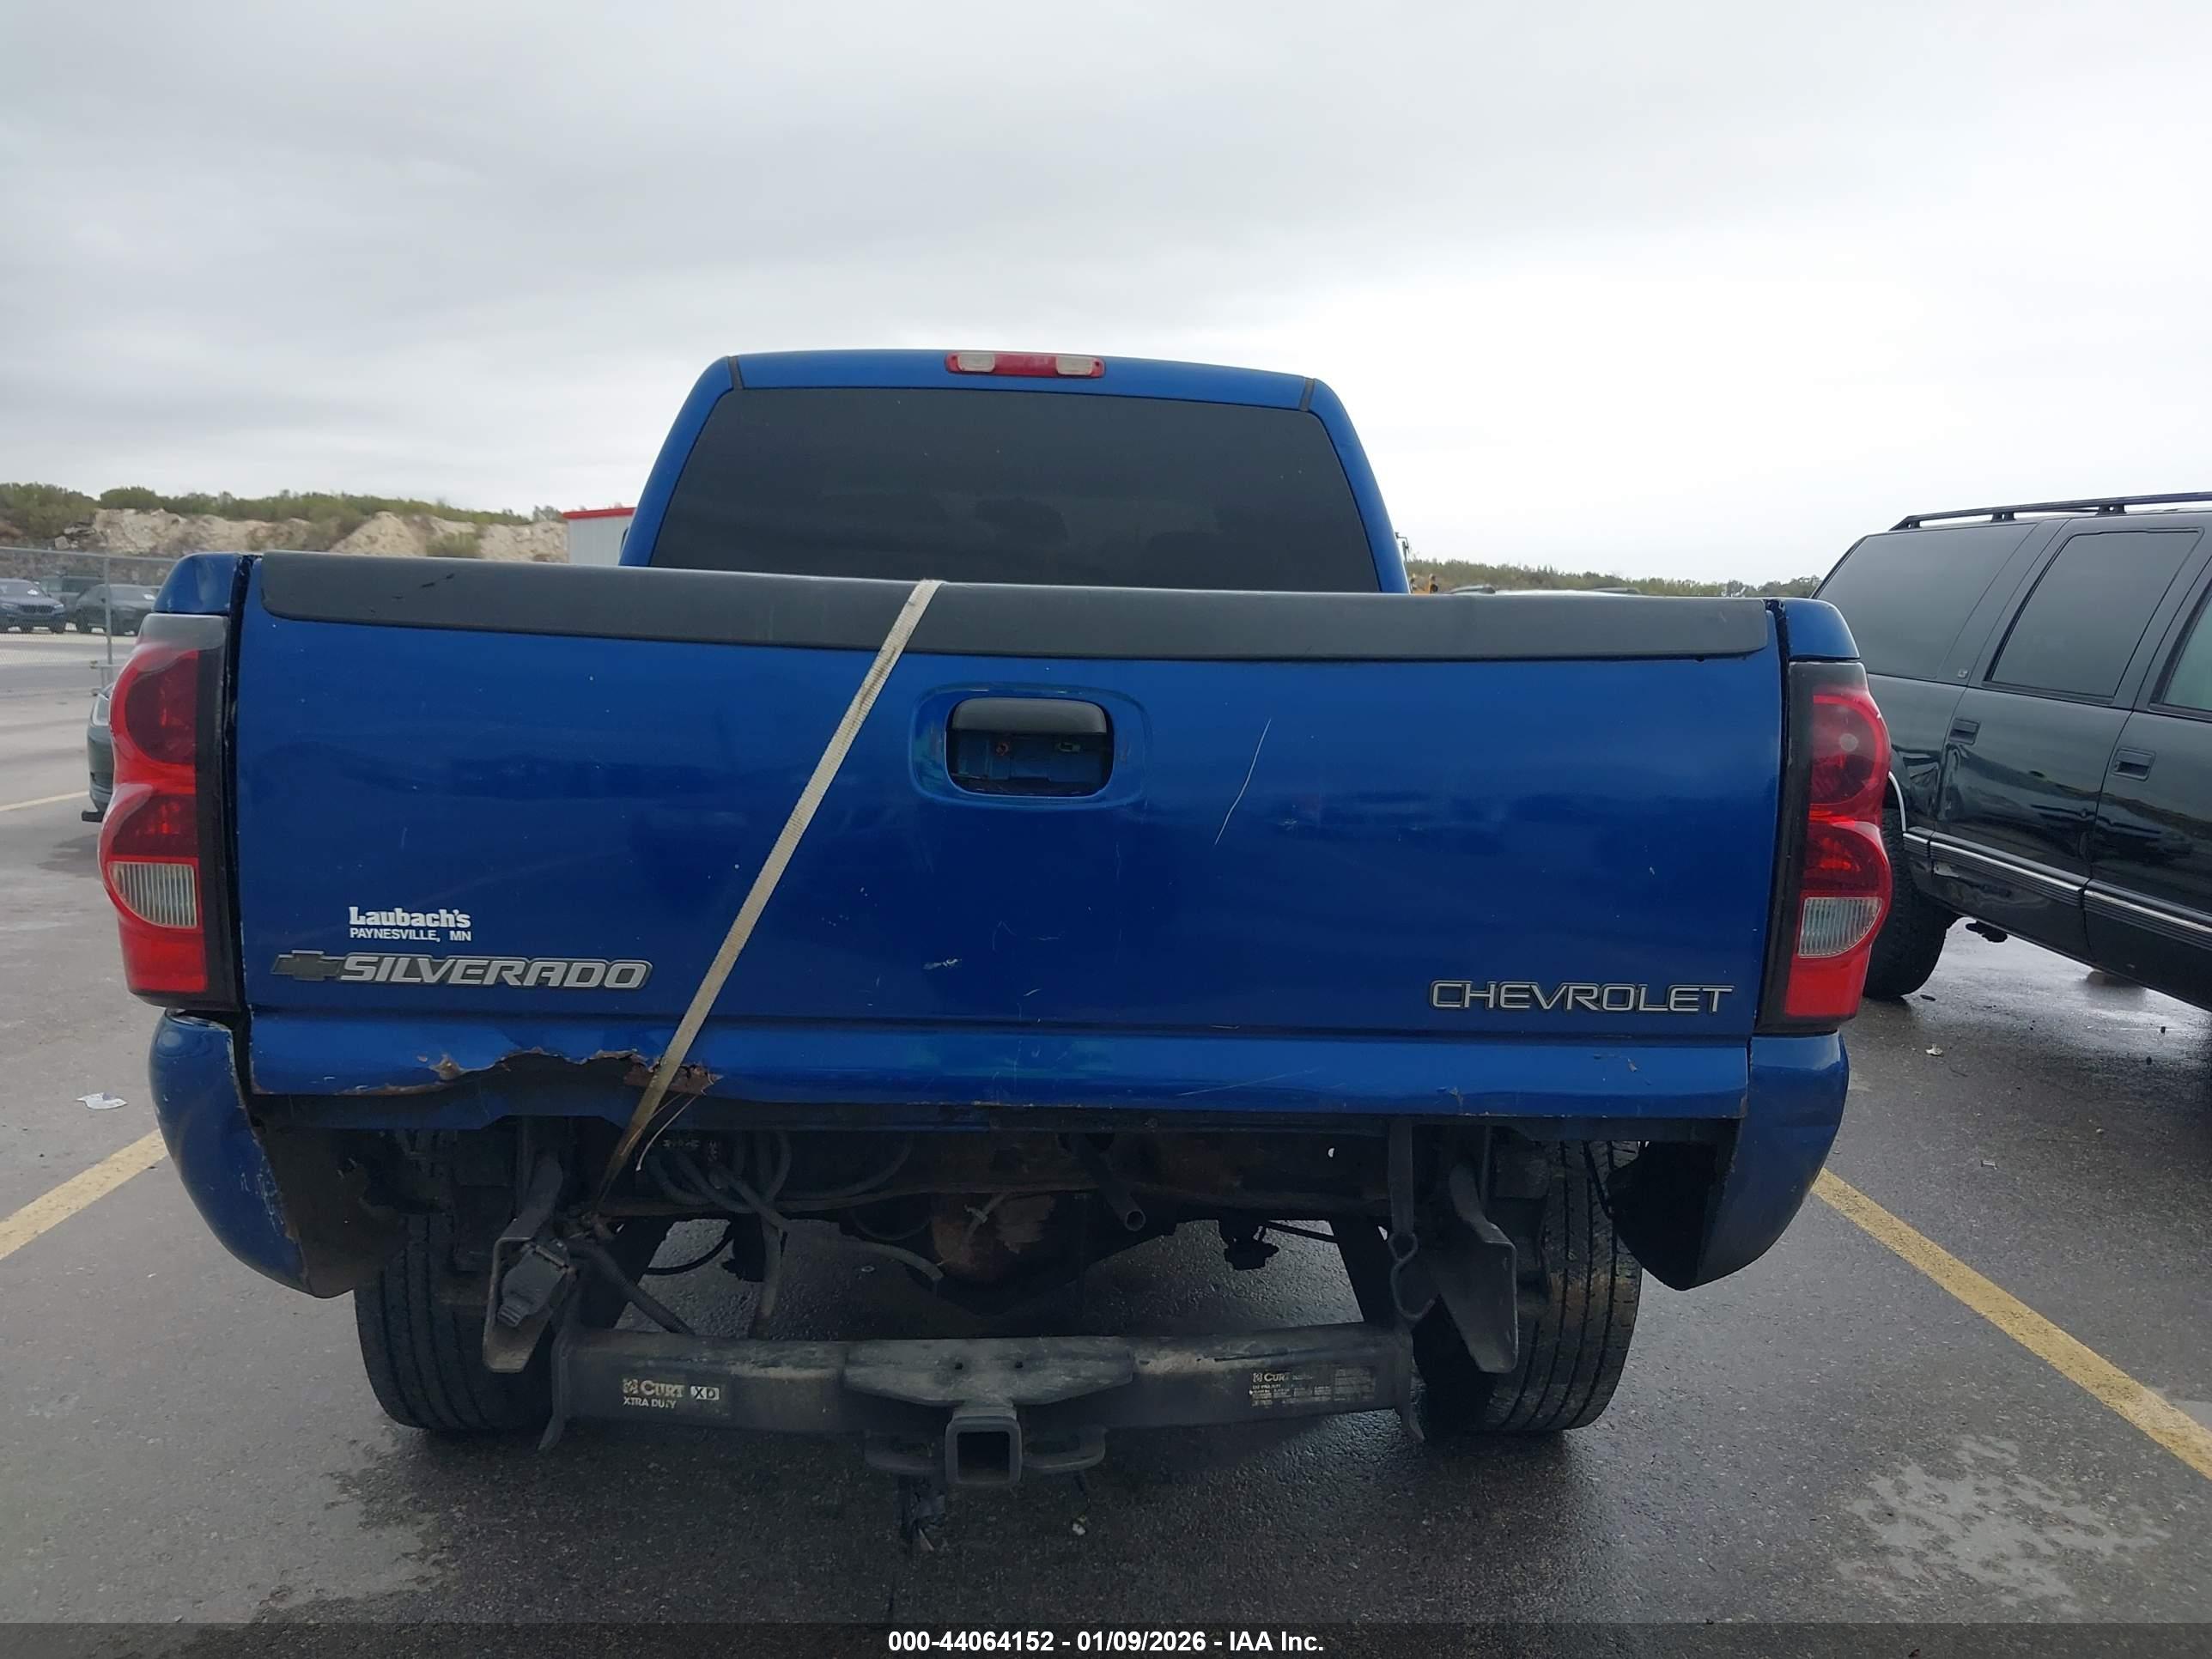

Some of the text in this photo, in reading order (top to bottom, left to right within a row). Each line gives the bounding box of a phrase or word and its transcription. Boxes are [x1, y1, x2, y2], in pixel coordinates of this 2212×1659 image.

[349, 906, 471, 928] Laubach's
[349, 927, 471, 943] PAYNESVILLE, MN
[340, 953, 653, 988] SILVERADO
[1431, 981, 1735, 1012] CHEVROLET
[640, 1380, 719, 1401] CURT XD
[623, 1396, 649, 1407] XTRA
